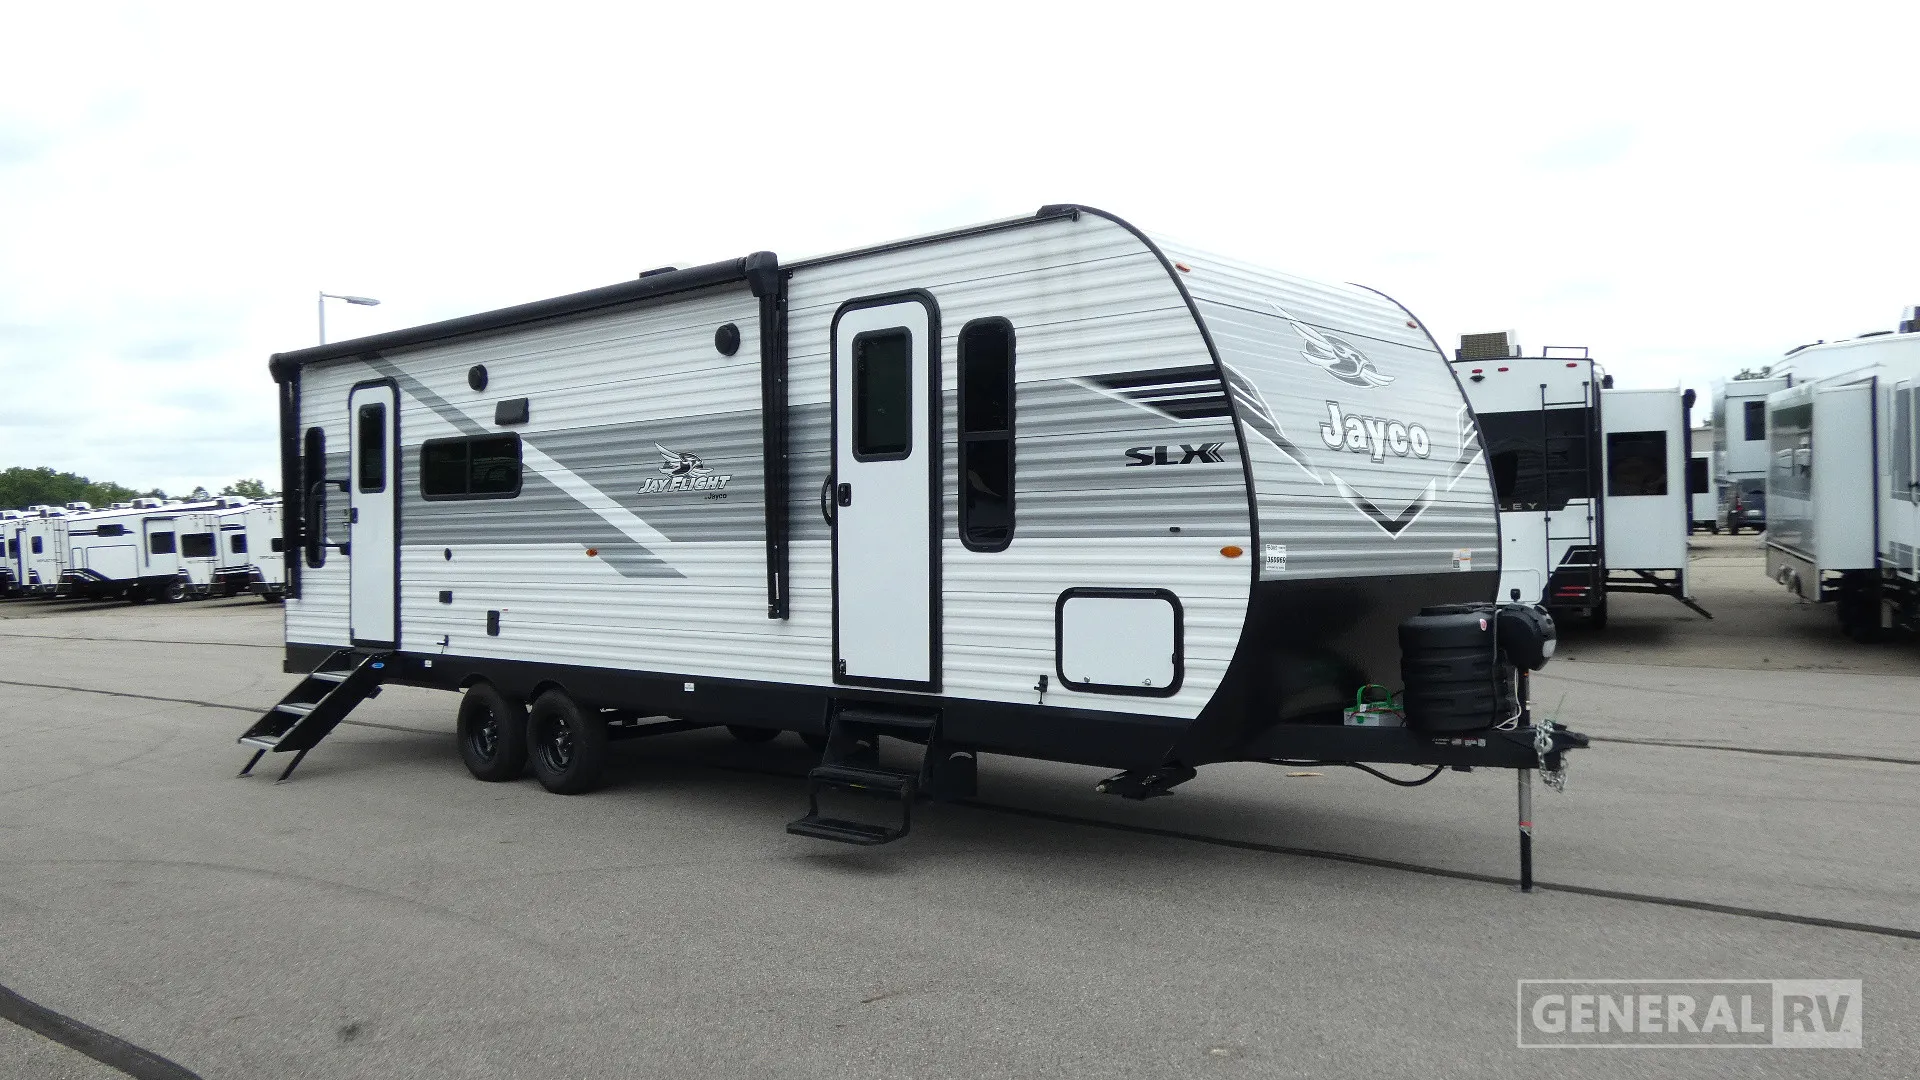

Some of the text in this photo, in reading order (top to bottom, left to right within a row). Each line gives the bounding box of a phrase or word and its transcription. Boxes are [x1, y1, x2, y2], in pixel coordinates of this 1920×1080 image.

[1319, 399, 1431, 464] Jayco
[1124, 441, 1226, 467] SLX
[637, 475, 732, 494] JAY FLIGHT
[707, 492, 728, 501] Jayco
